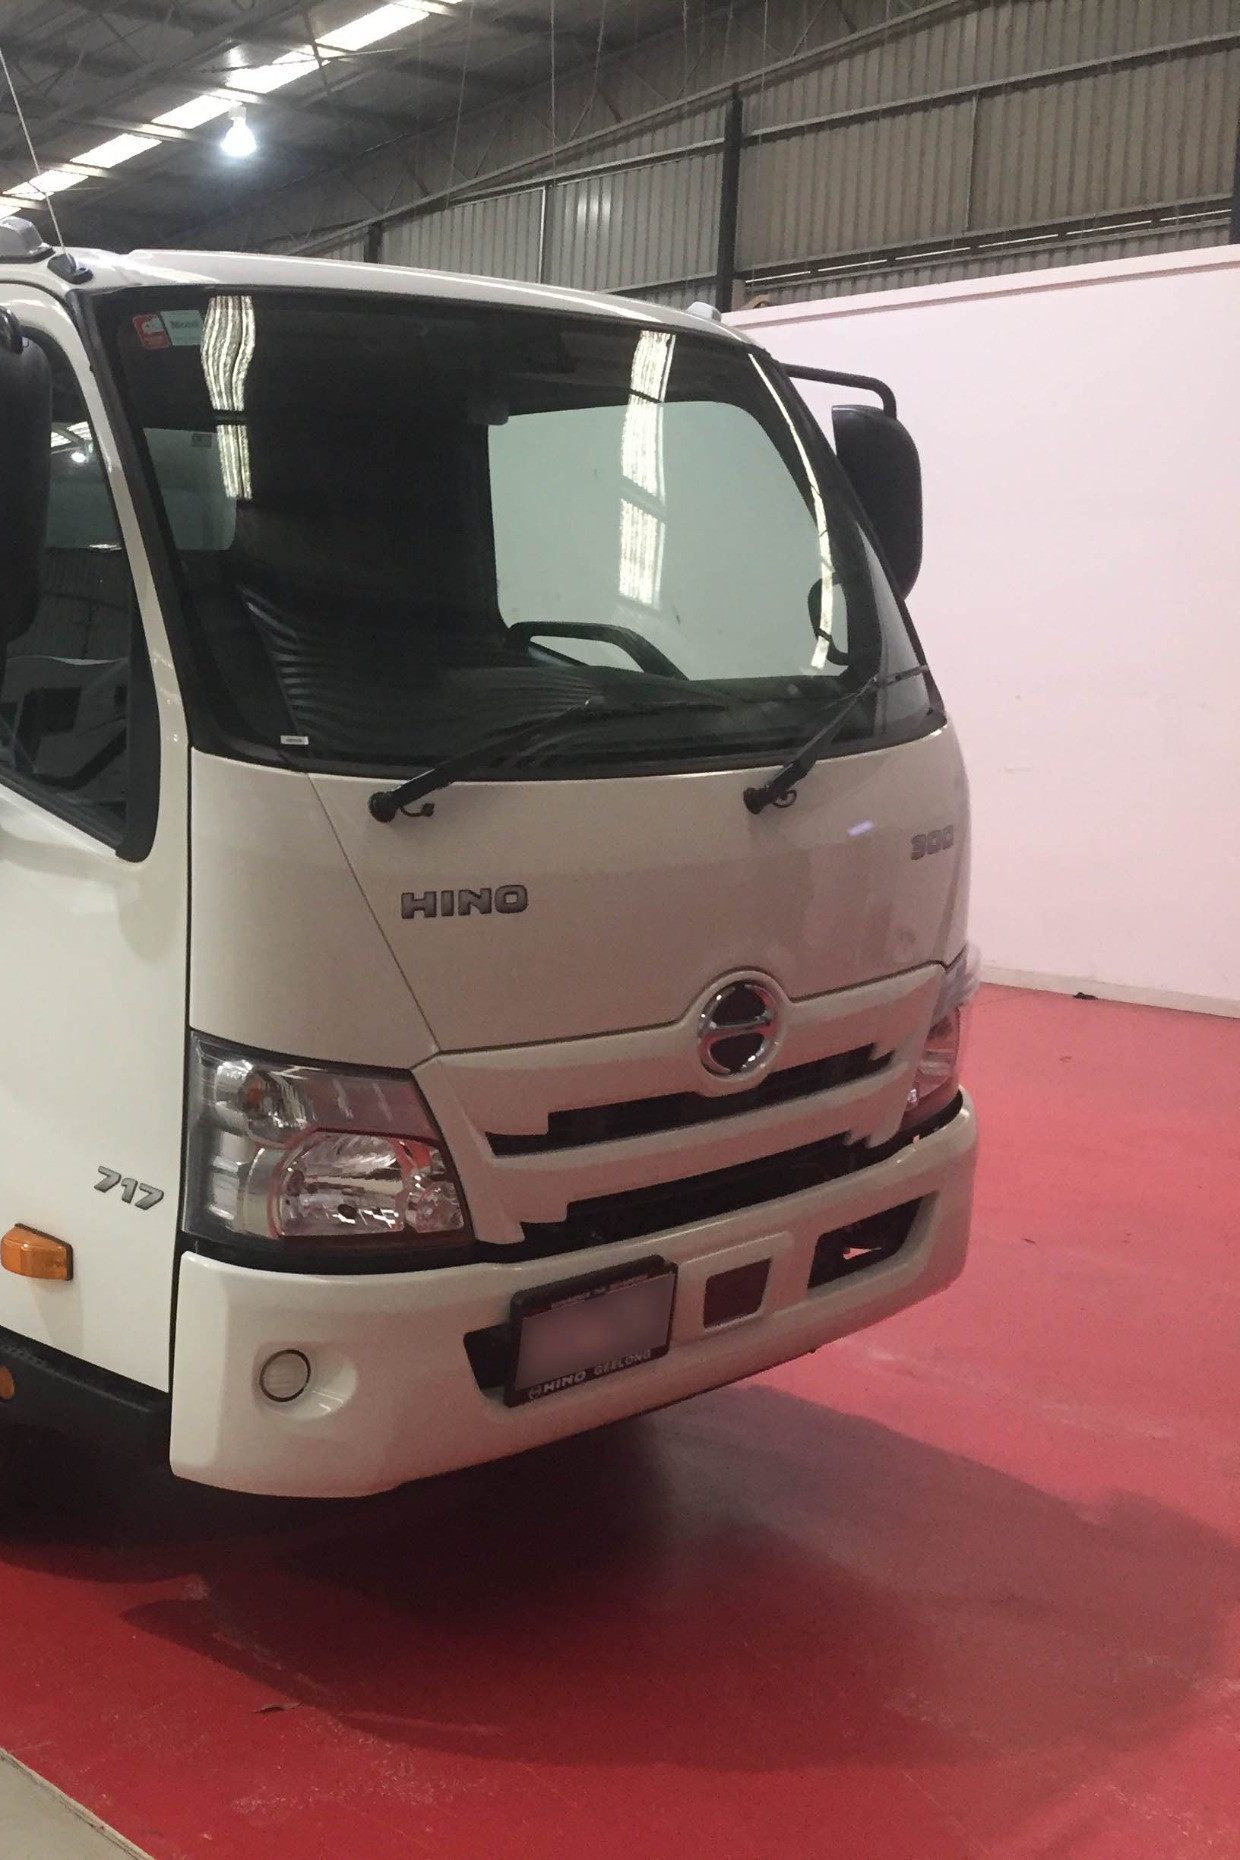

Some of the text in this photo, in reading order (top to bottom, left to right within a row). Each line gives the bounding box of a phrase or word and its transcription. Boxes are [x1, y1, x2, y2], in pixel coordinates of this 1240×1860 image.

[401, 884, 528, 919] HINO
[93, 1165, 165, 1211] 717
[543, 1348, 652, 1394] HINO GEELONG
